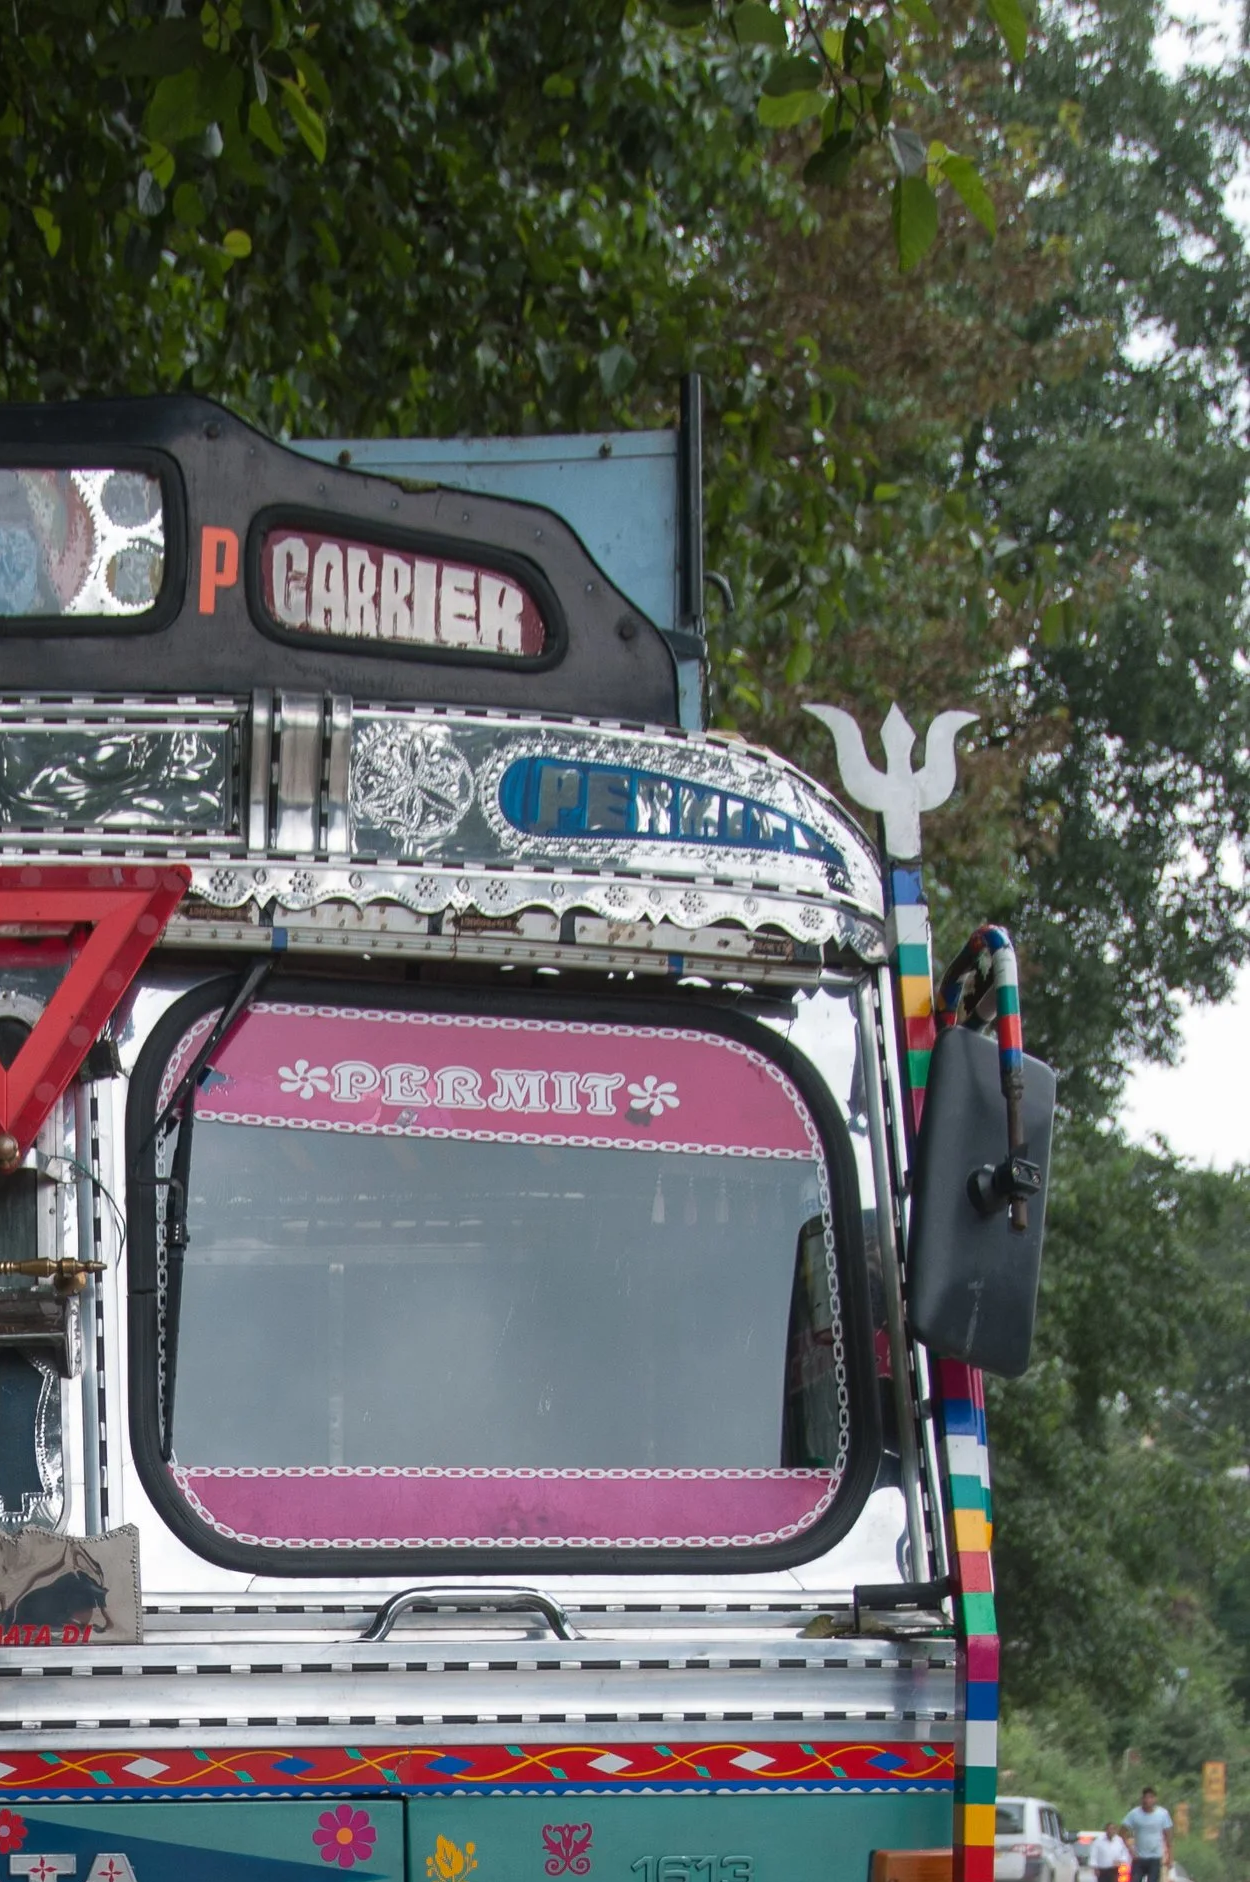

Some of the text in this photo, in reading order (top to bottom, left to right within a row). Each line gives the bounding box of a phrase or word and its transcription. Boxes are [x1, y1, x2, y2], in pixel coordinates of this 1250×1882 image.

[199, 525, 239, 615] P
[272, 537, 524, 655] CARRIER
[331, 1060, 625, 1115] PERMIT
[61, 1623, 94, 1645] DI
